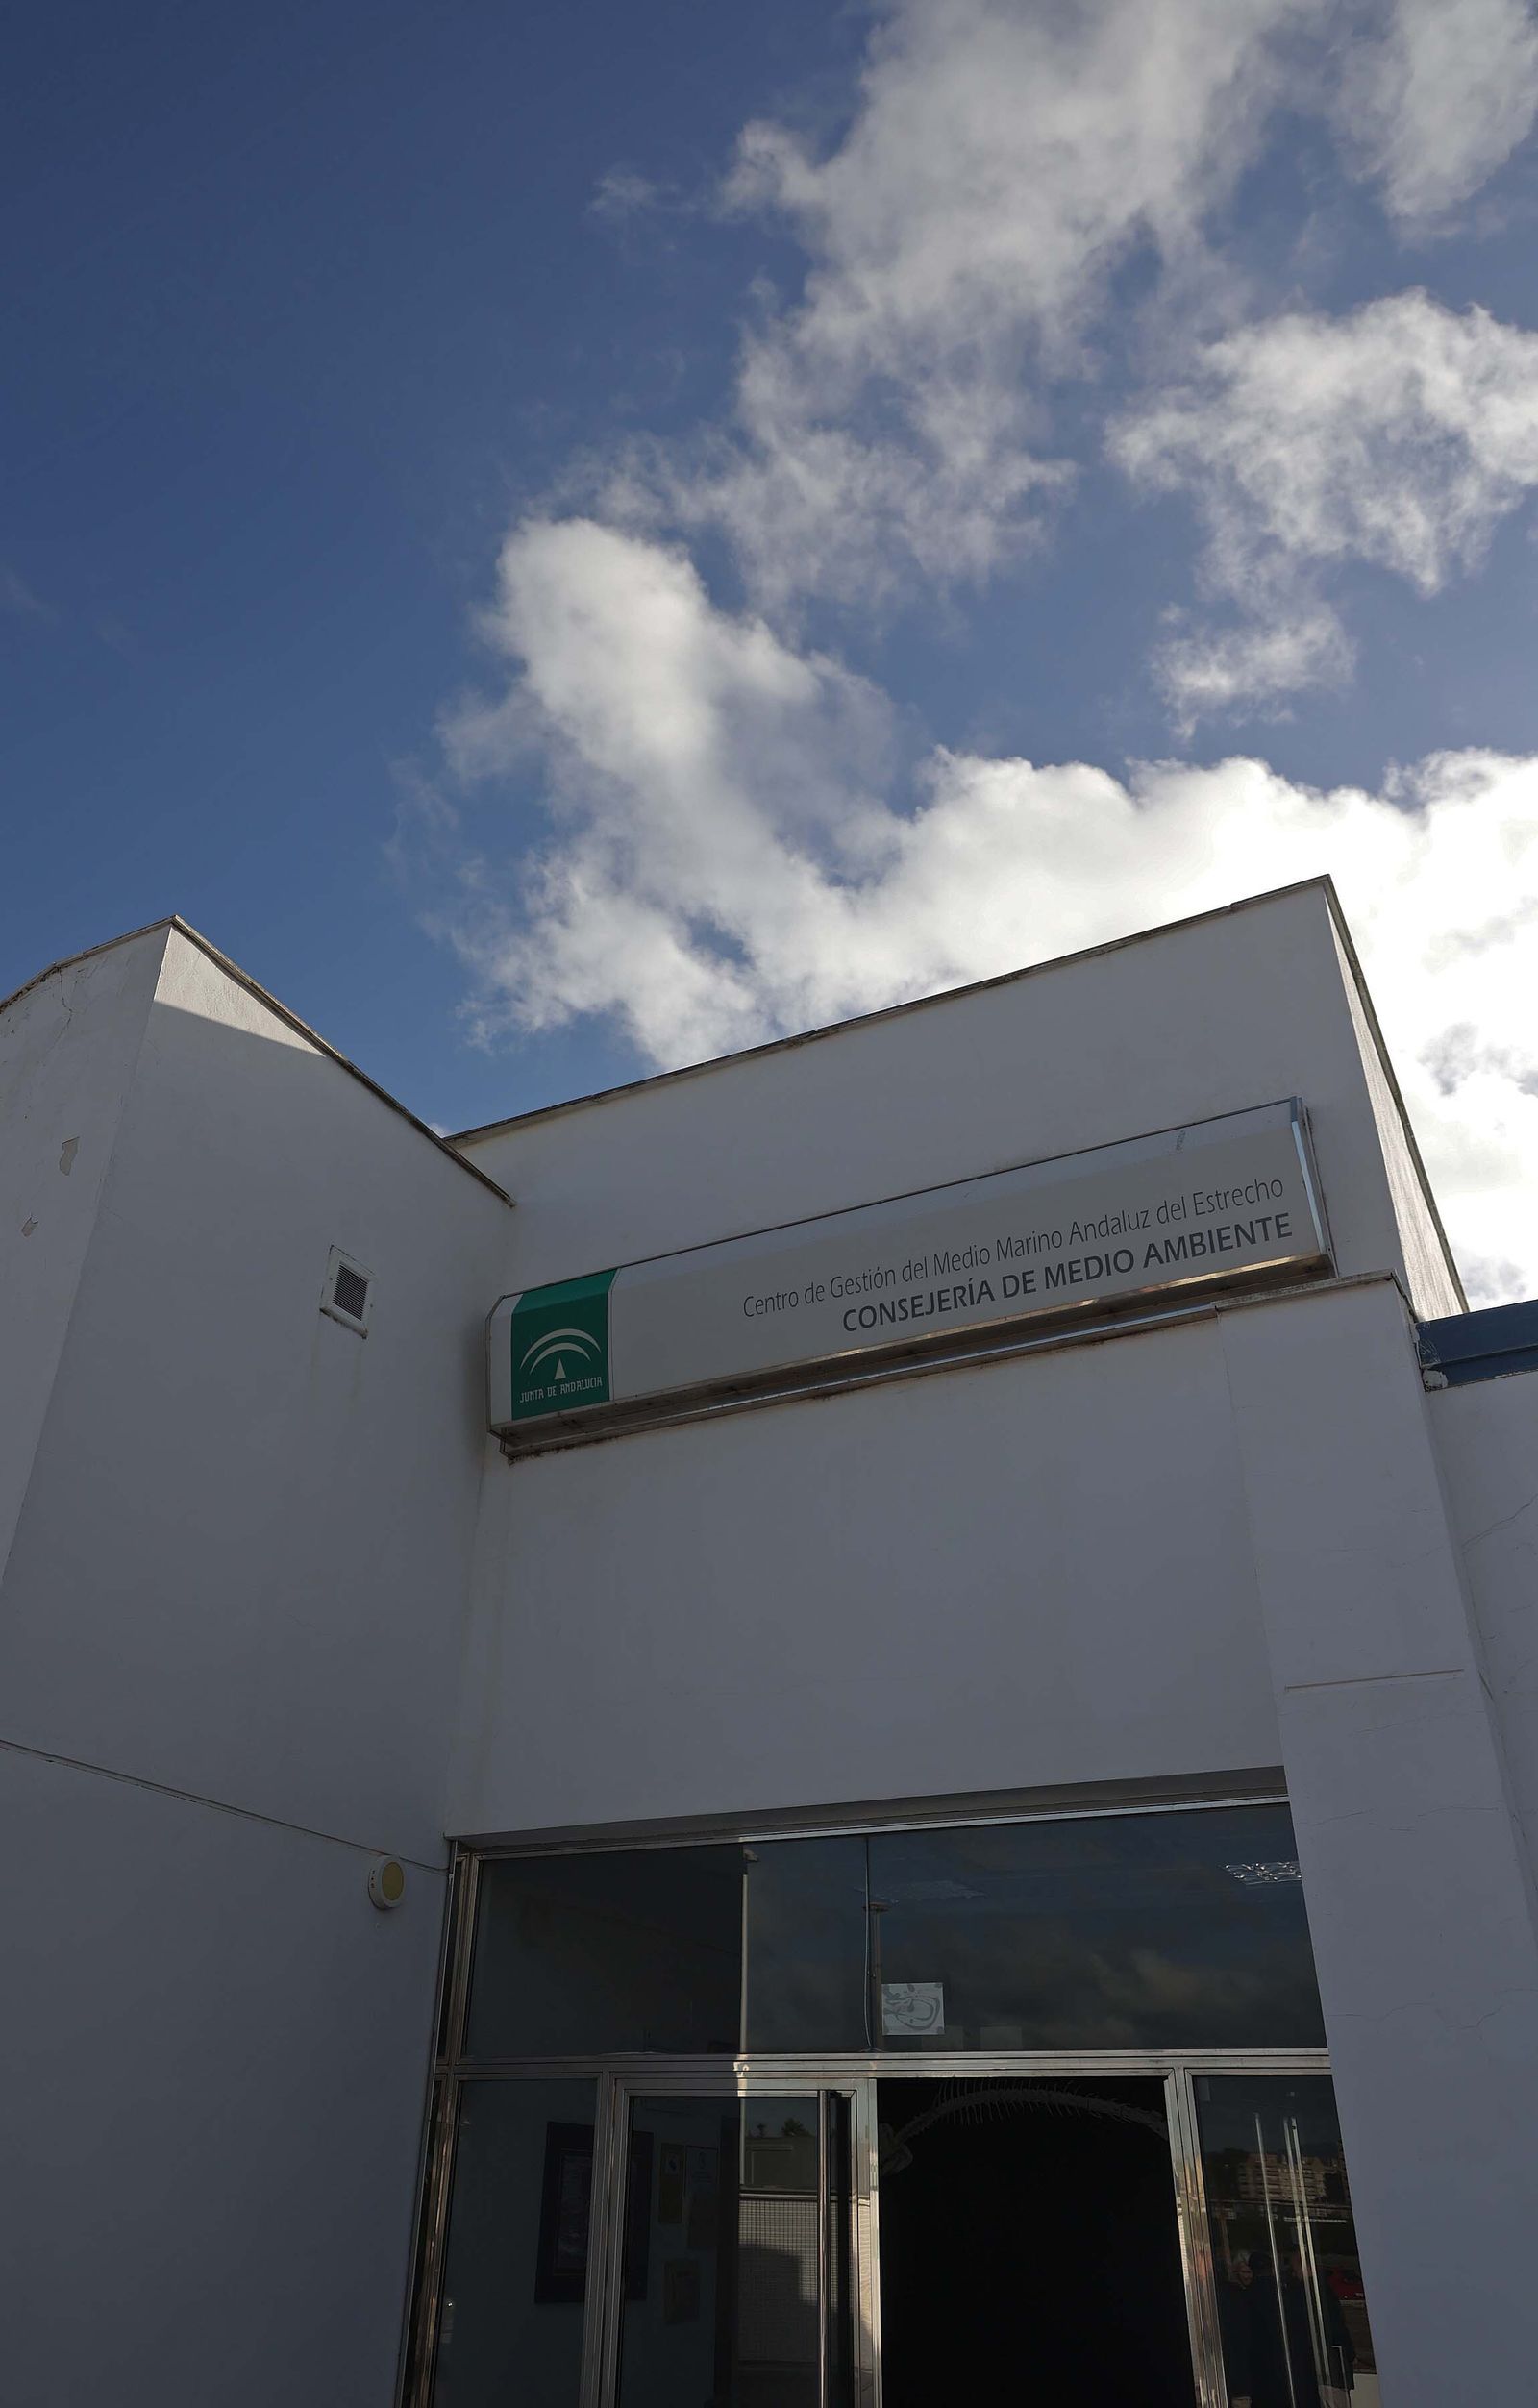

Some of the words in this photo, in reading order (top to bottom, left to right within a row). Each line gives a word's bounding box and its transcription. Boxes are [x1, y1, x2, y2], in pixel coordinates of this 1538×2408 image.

[743, 1289, 799, 1318] Centro
[804, 1282, 825, 1305] de
[830, 1265, 896, 1299] Gestión
[902, 1255, 929, 1283] del
[933, 1244, 991, 1276] Medio
[996, 1229, 1063, 1262] Marino
[1068, 1209, 1151, 1245] Andaluz
[1156, 1196, 1187, 1225] del
[1192, 1179, 1284, 1217] Estrecho
[843, 1277, 995, 1332] CONSEJERÍA
[1002, 1269, 1037, 1298] DE
[1044, 1249, 1134, 1290] MEDIO
[1143, 1212, 1293, 1269] AMBIENTE
[520, 1388, 544, 1403] JUNTA
[547, 1385, 557, 1398] DE
